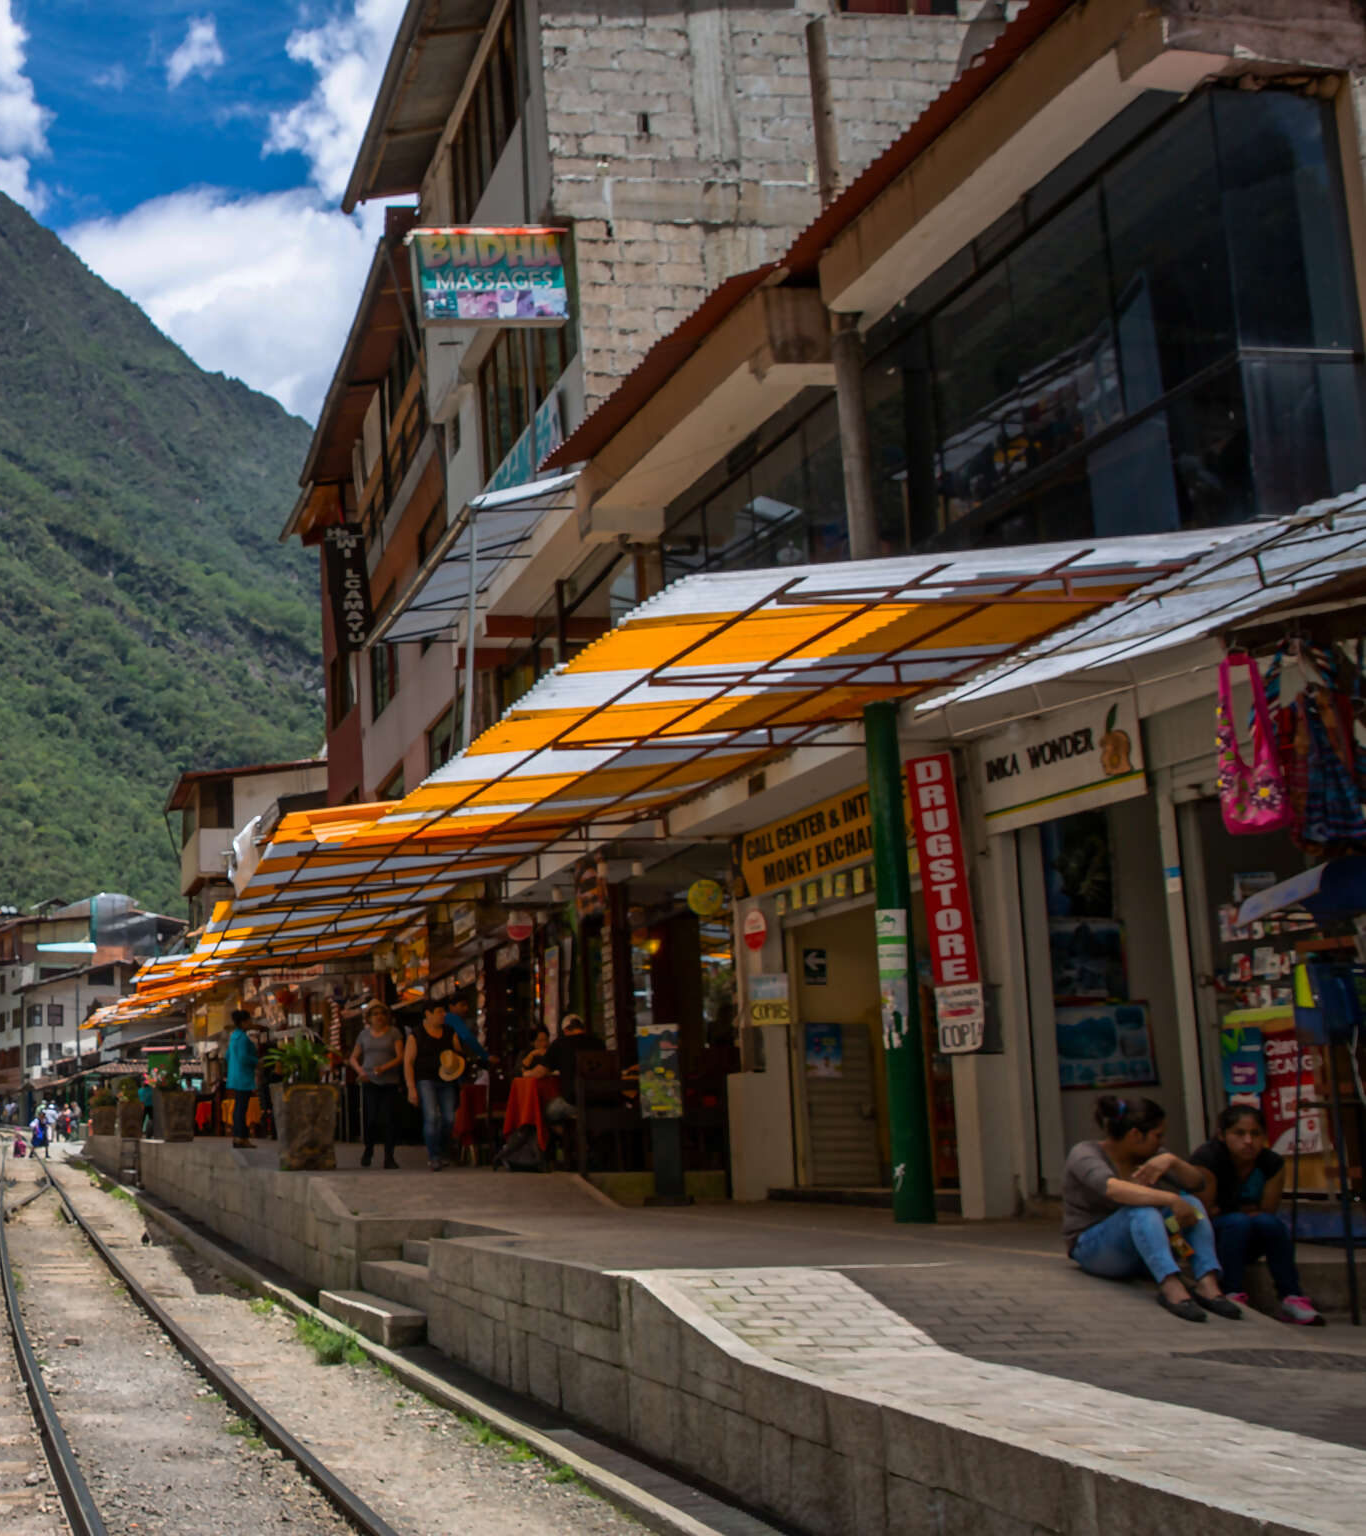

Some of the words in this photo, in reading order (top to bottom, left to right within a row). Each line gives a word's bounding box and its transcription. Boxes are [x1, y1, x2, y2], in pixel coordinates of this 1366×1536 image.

[419, 234, 562, 268] BUDHA
[435, 271, 553, 290] MASSAGES
[985, 752, 1020, 783] INKA
[1026, 727, 1095, 770] WONDER
[745, 832, 775, 861] CALL
[776, 810, 826, 849] CENTER
[829, 808, 840, 829] &
[763, 848, 812, 887] MONEY
[815, 825, 874, 868] EXCHA
[914, 759, 969, 982] DRUGSTORE
